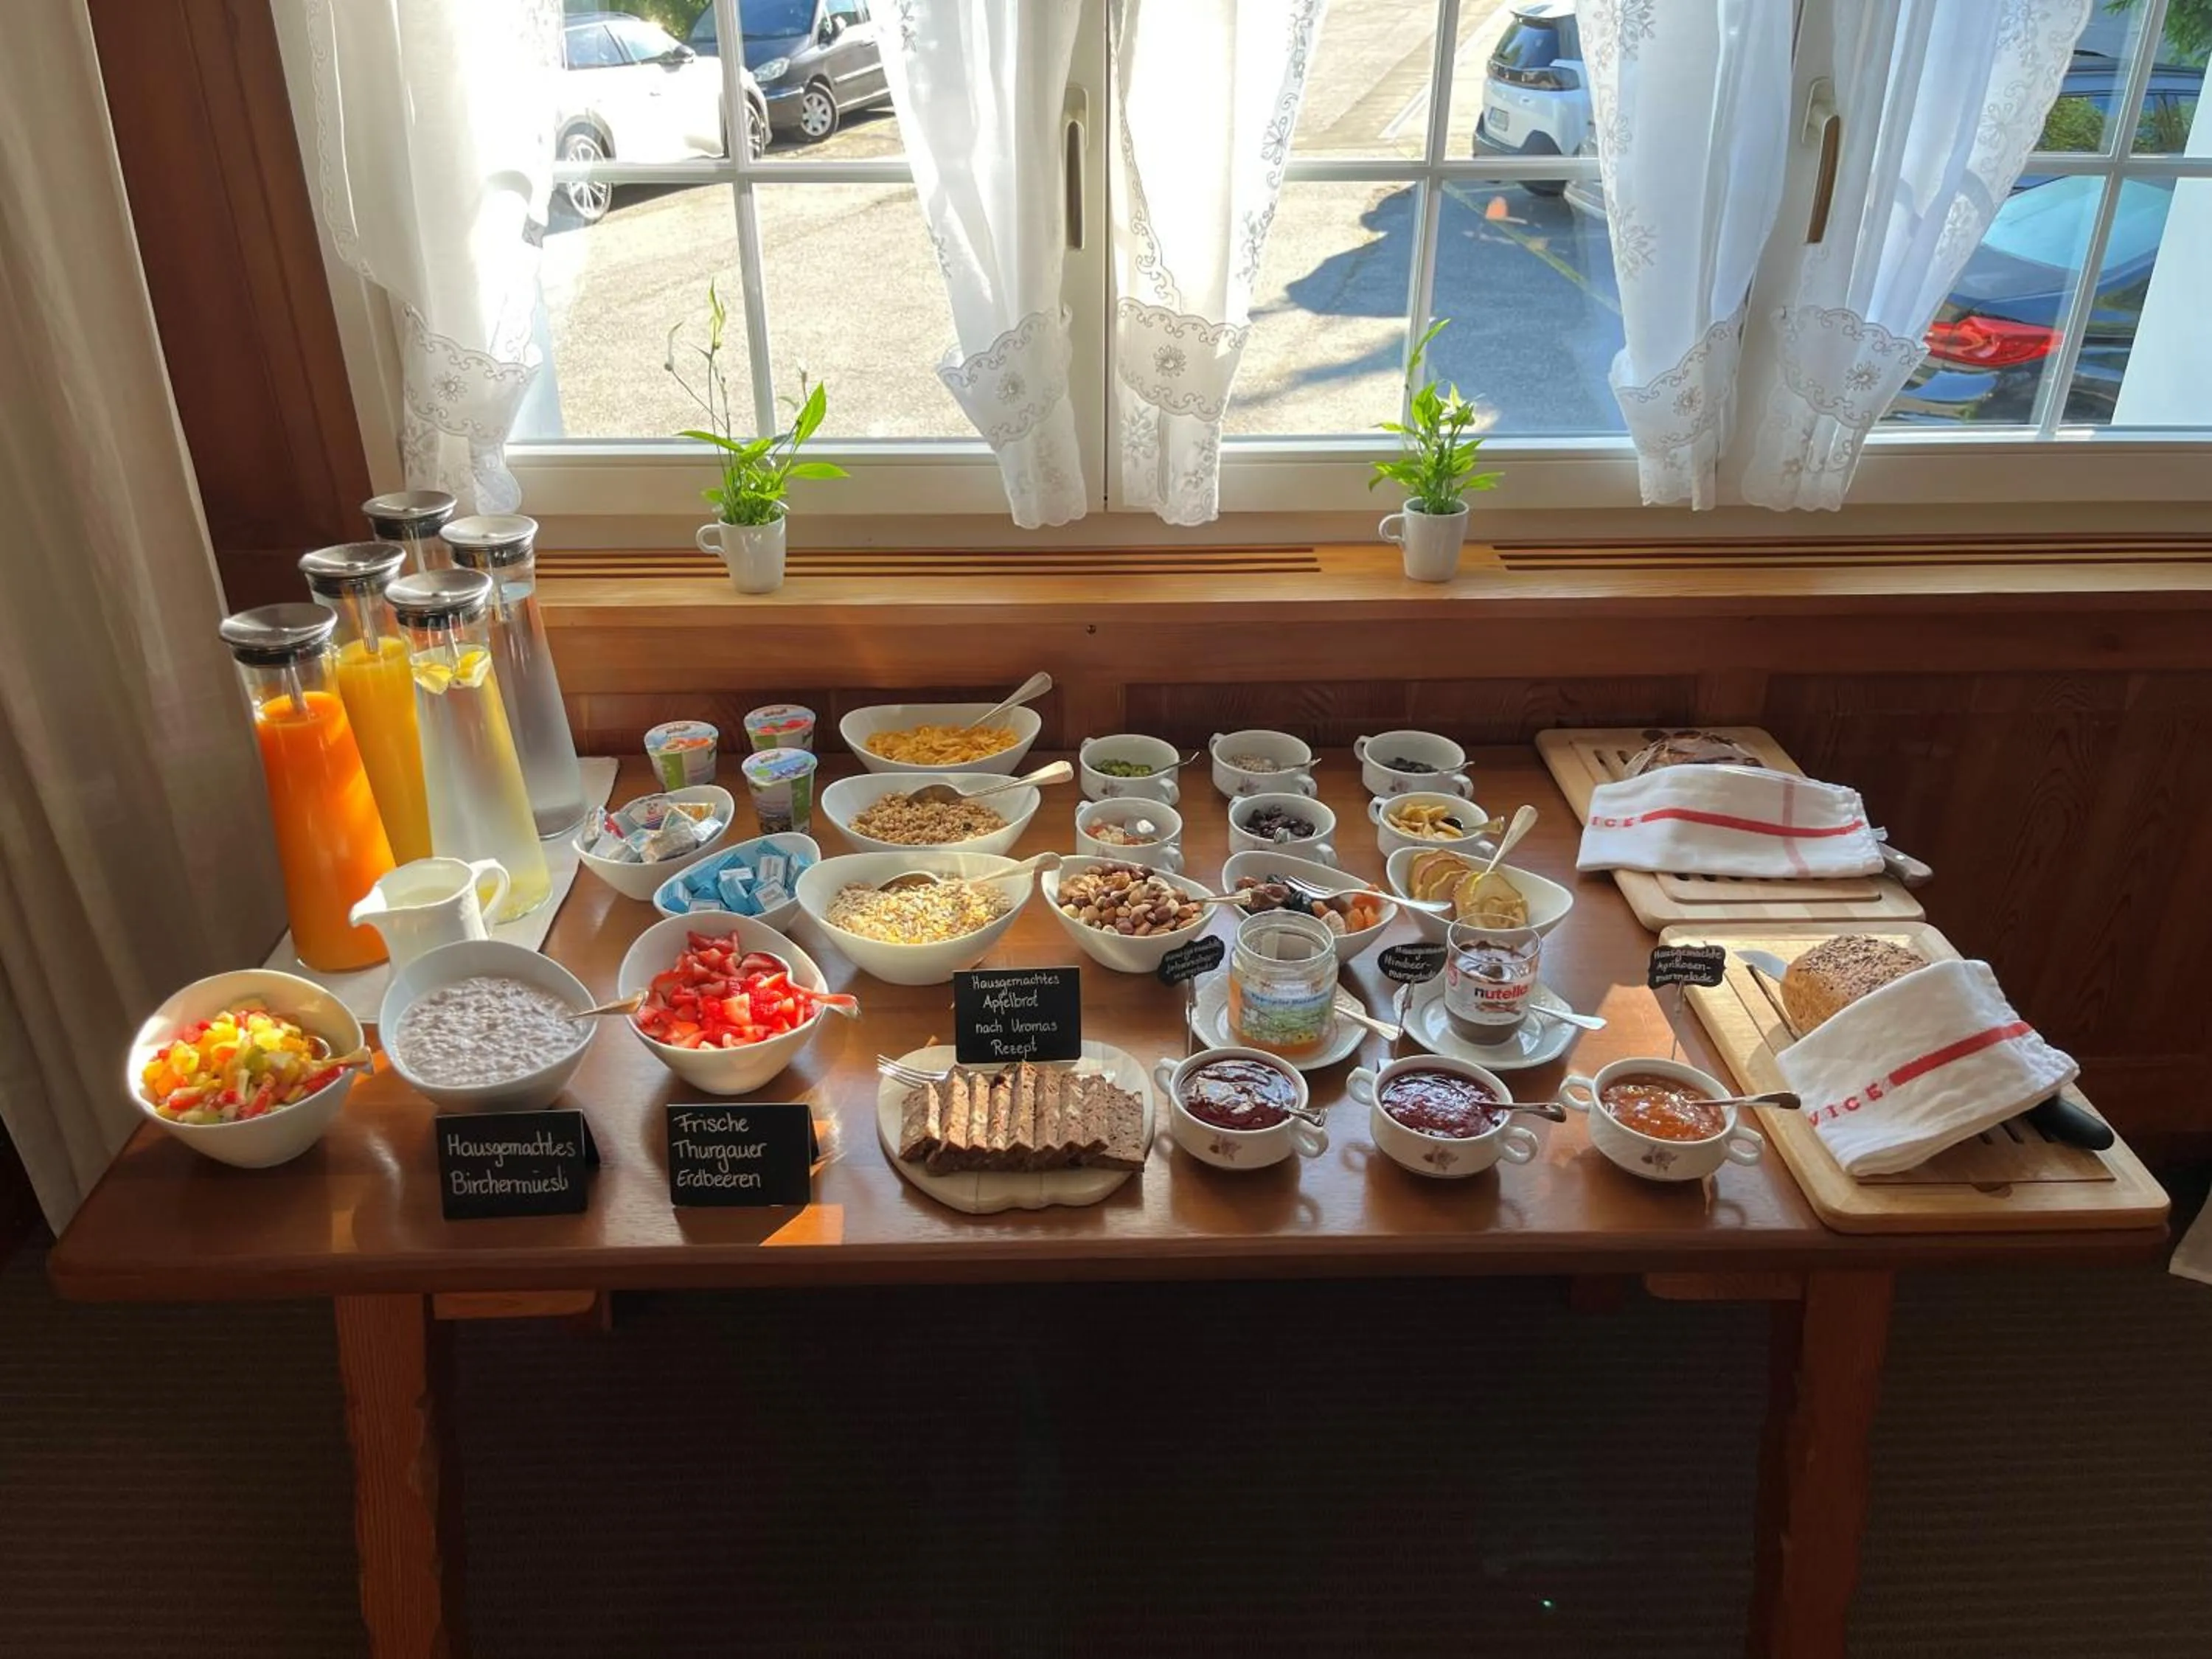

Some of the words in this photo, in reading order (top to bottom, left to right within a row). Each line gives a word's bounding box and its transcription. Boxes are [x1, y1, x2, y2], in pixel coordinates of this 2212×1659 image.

[972, 973, 1060, 998] Hausgemachtes
[1474, 984, 1528, 1000] nutella
[983, 989, 1039, 1015] Apfelbrot
[975, 1019, 1003, 1034] nach
[1011, 1018, 1058, 1032] Uromas
[991, 1034, 1037, 1060] Rezept
[672, 1112, 750, 1133] Frische
[448, 1130, 577, 1167] Hausgemachtes
[672, 1139, 768, 1173] Thurgauer
[677, 1169, 762, 1188] Erdbeeren
